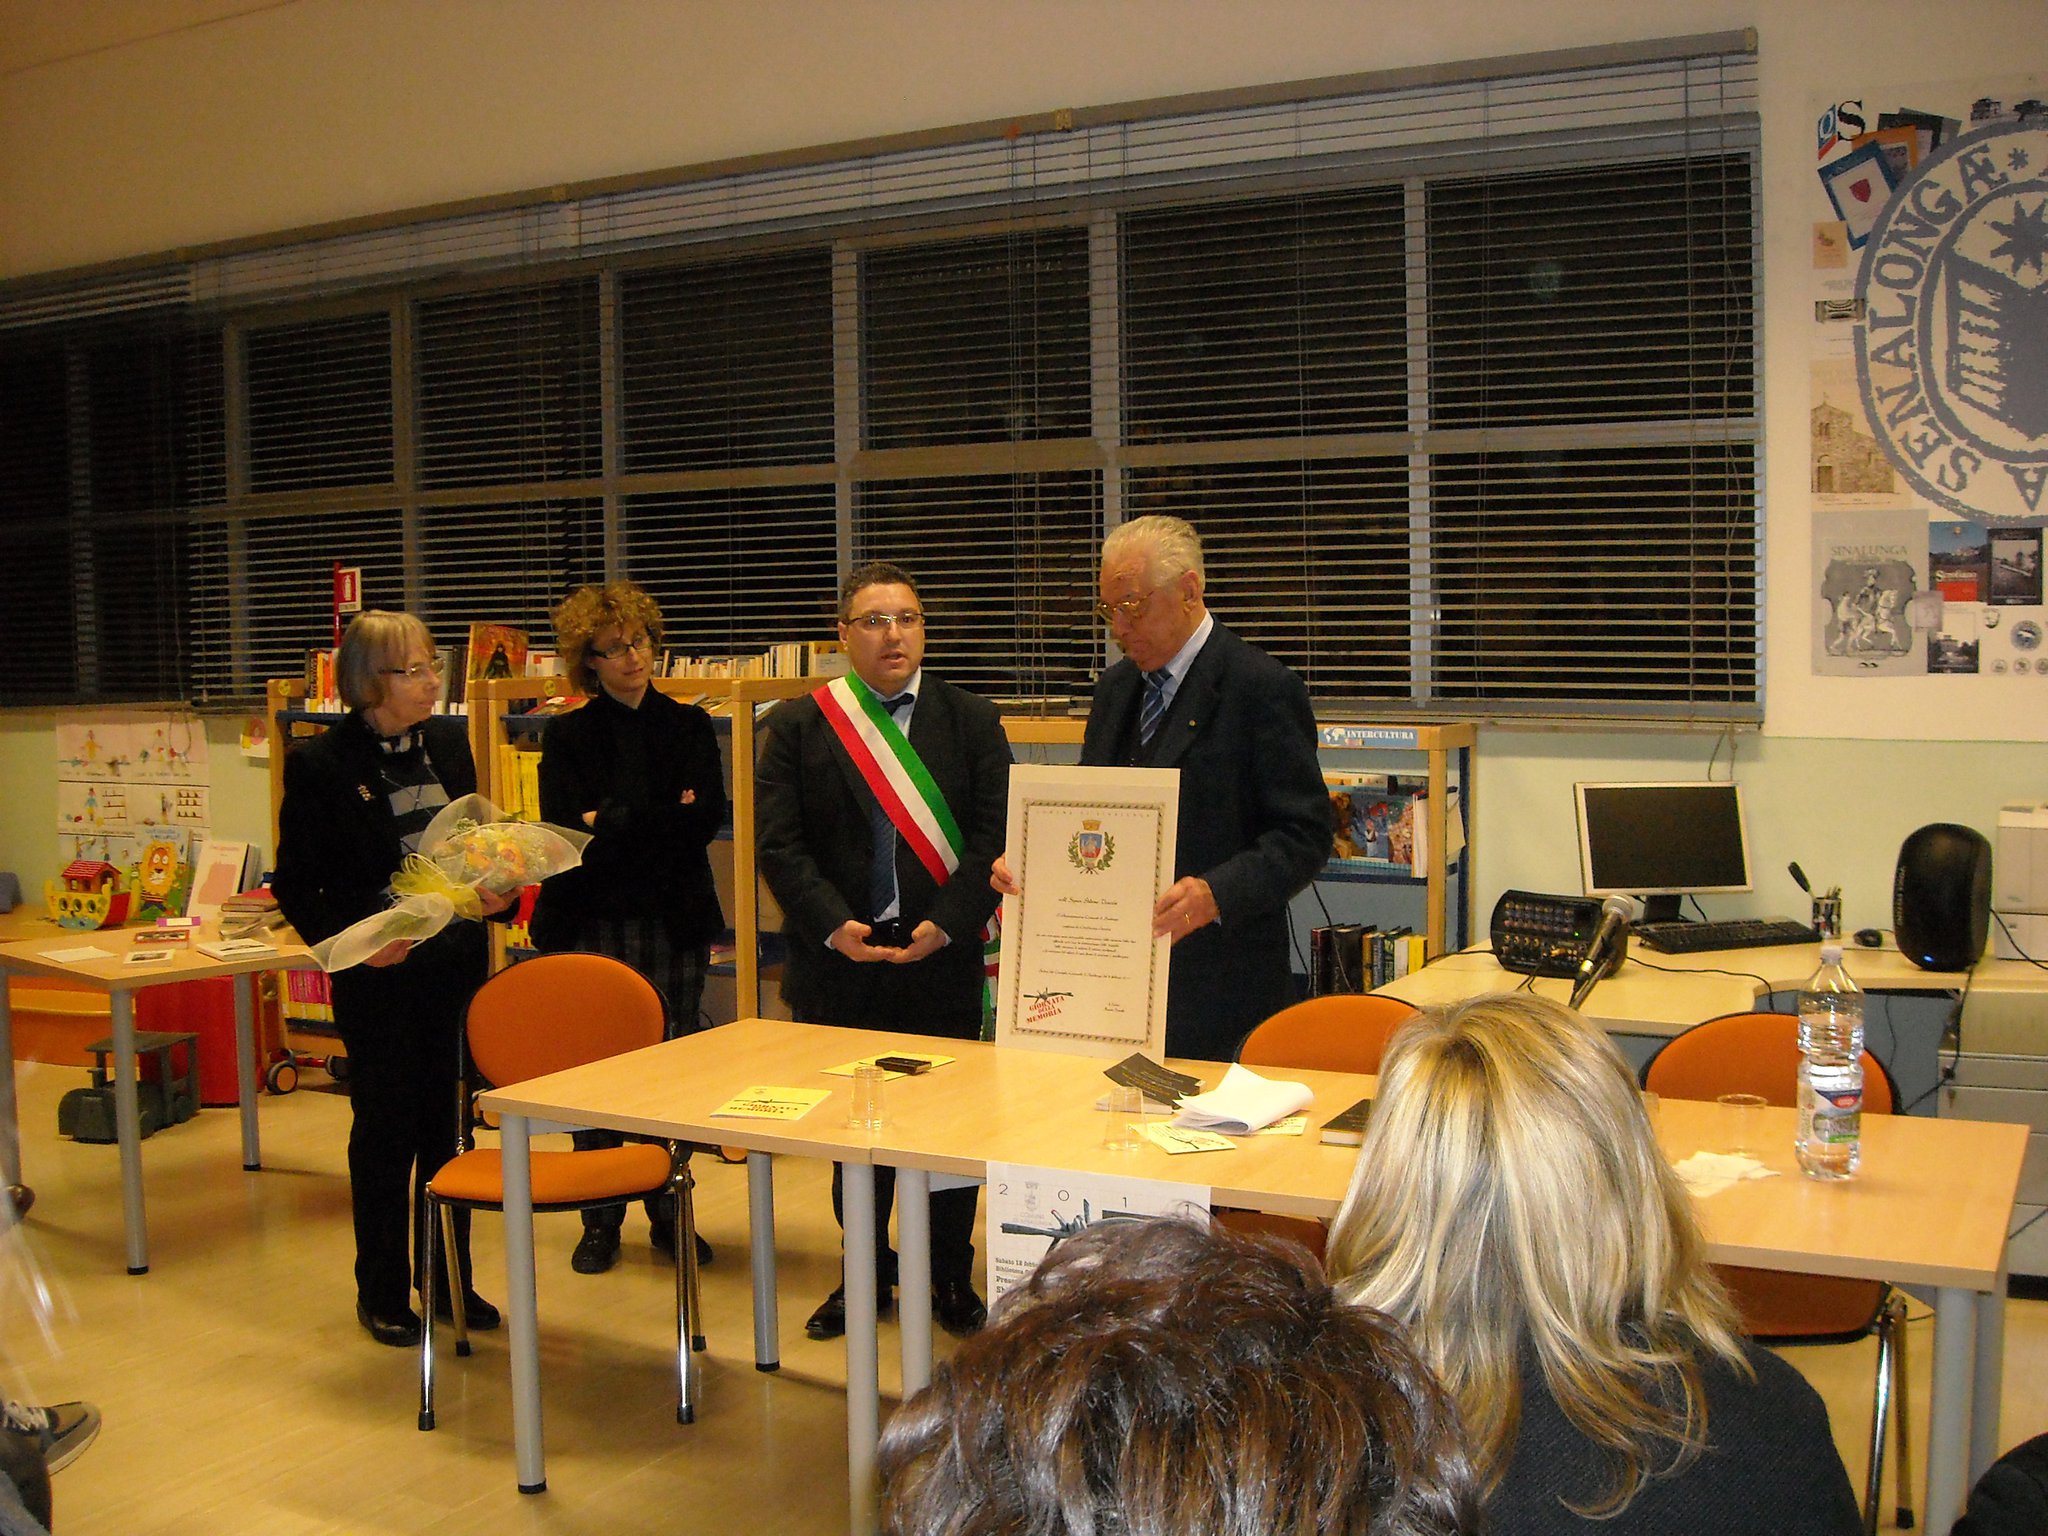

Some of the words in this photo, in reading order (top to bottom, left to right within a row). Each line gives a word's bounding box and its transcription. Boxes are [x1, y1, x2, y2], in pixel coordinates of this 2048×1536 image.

[1347, 730, 1414, 739] INTERCULTURA
[1029, 996, 1065, 1011] GIORNATA
[1026, 1008, 1062, 1023] MEMORIA
[995, 1257, 1015, 1266] Sabato
